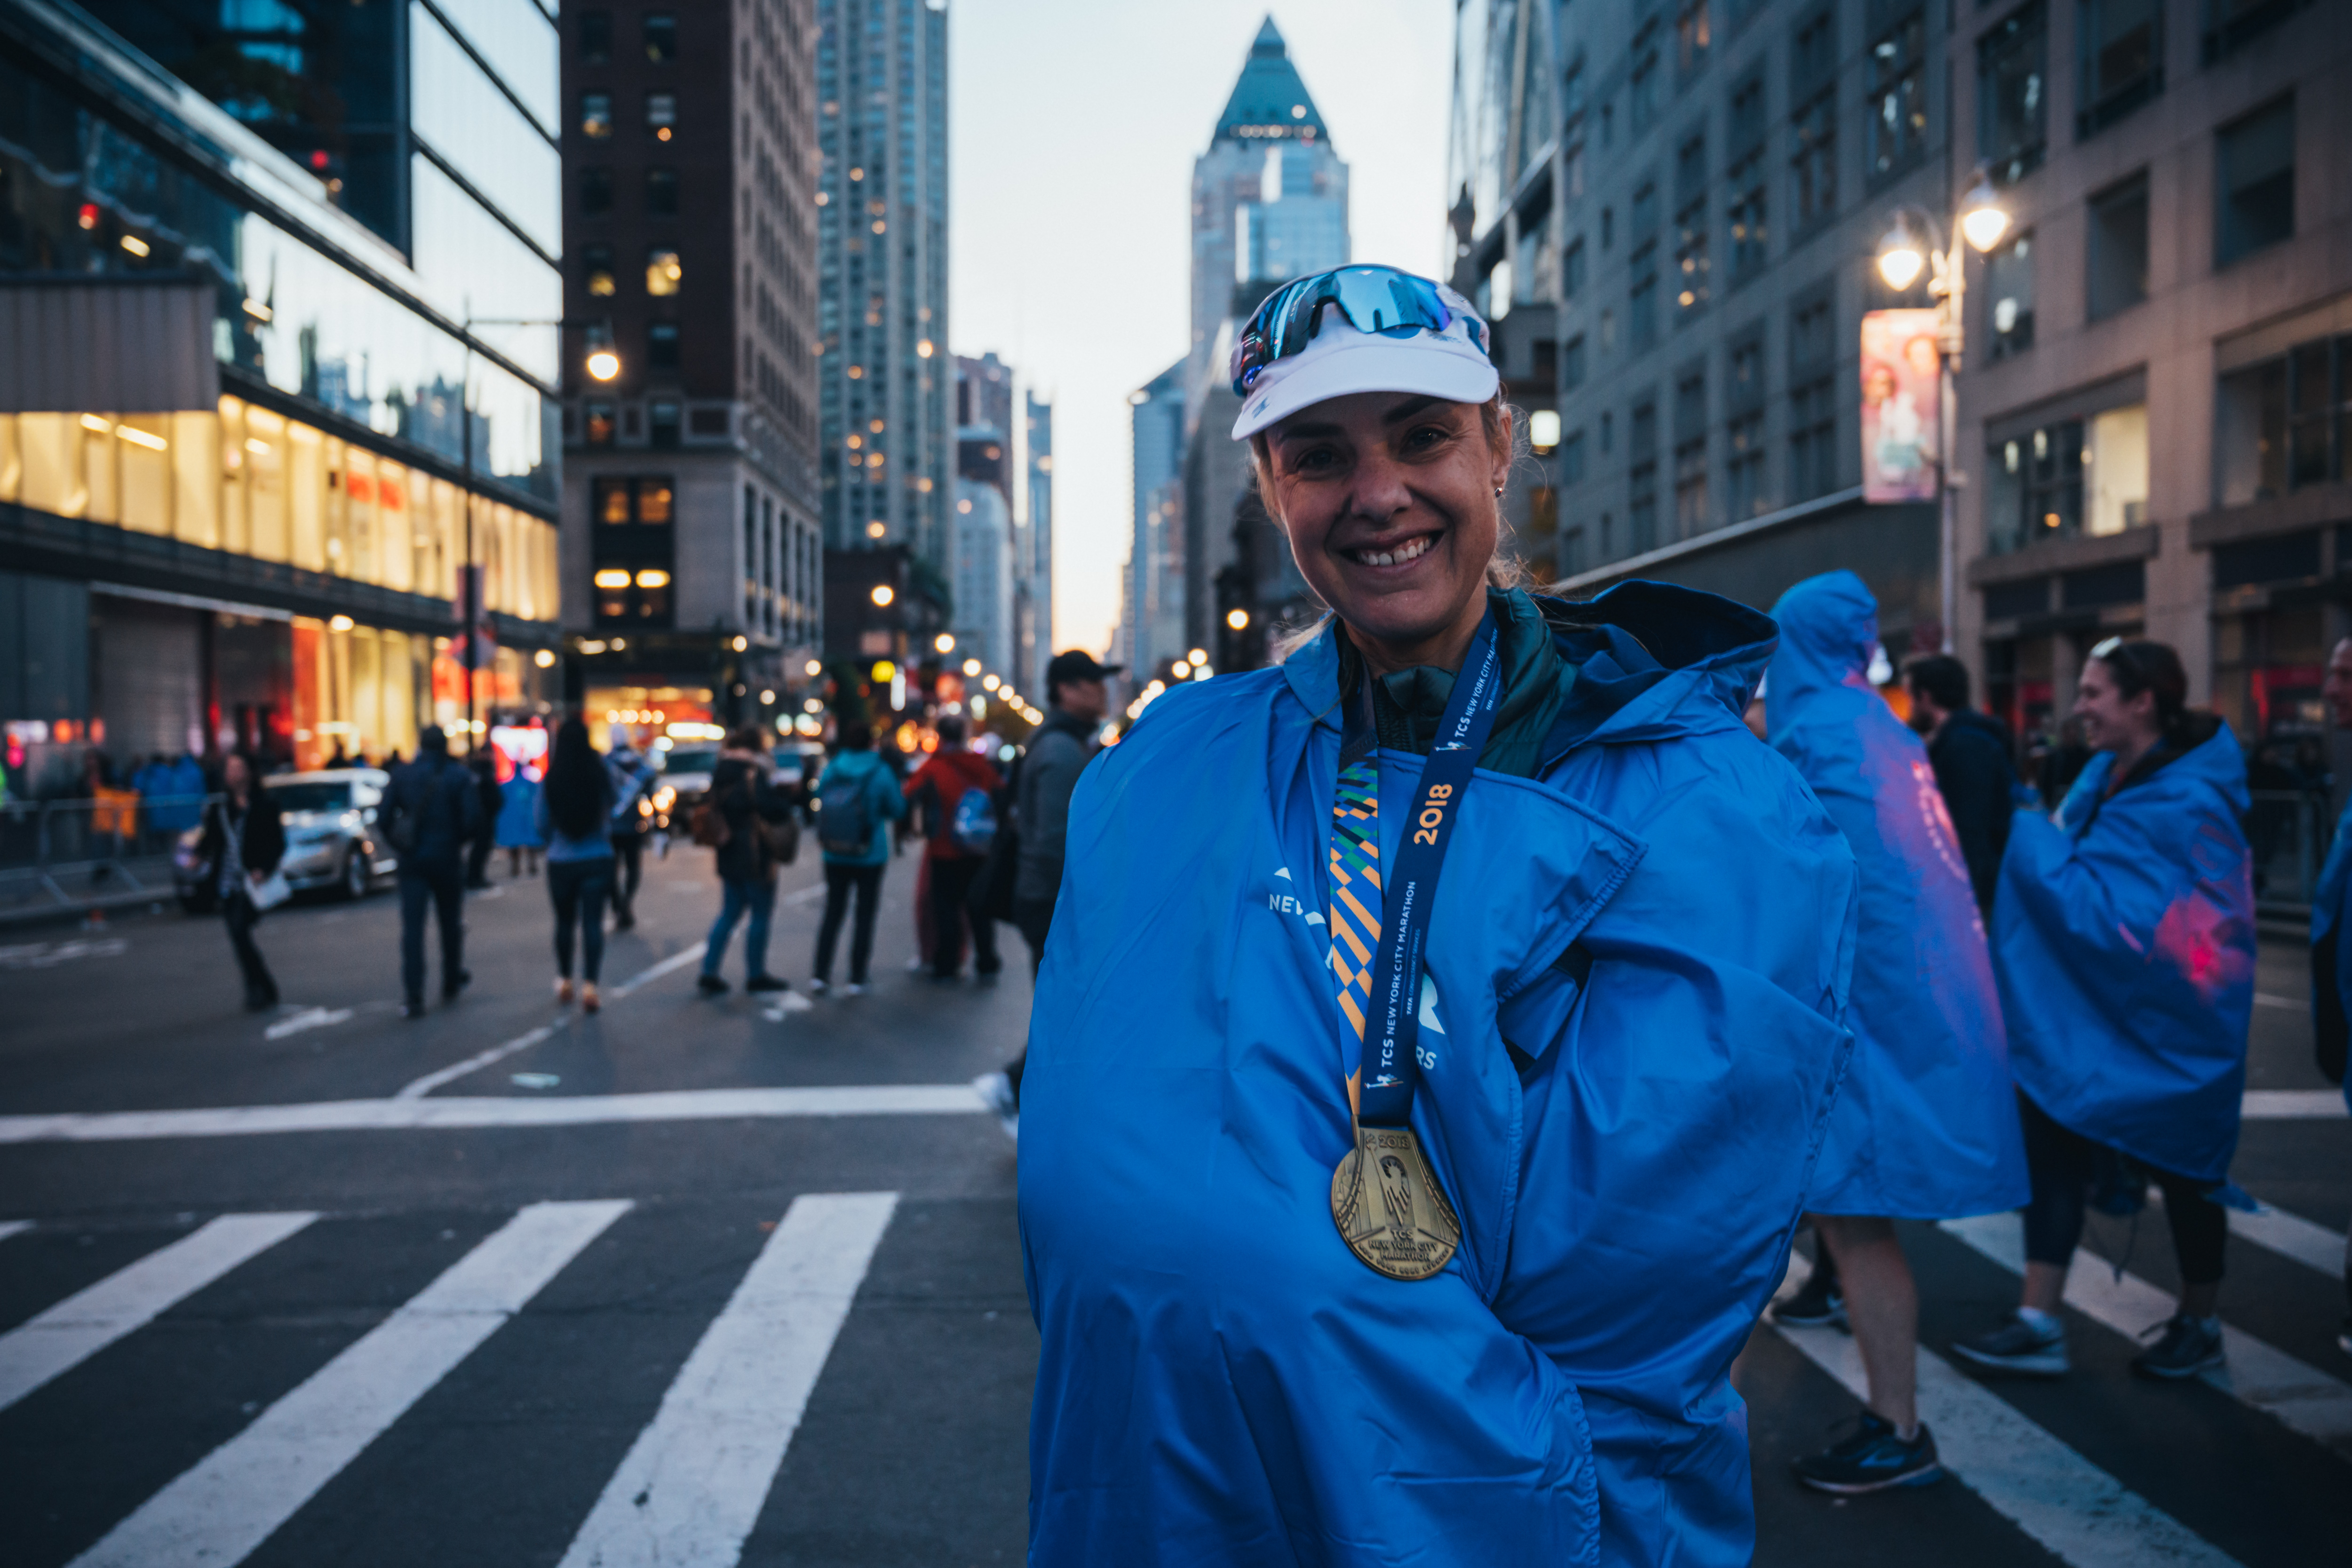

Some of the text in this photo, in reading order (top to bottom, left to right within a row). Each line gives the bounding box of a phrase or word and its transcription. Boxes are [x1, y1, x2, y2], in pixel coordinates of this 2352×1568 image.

[1454, 716, 1470, 737] TCS
[1465, 697, 1478, 717] NEW
[1472, 676, 1486, 698] YORK
[1480, 660, 1492, 678] CITY
[1414, 784, 1453, 845] 2018
[1381, 881, 1416, 1067] TCS NEW YORK CITY MARATHON
[1416, 1045, 1437, 1070] RS
[1378, 1135, 1410, 1149] 2018
[1391, 1228, 1414, 1240] TCS
[1368, 1240, 1438, 1252] NEW YORK CITY
[1380, 1251, 1430, 1262] MARATHON
